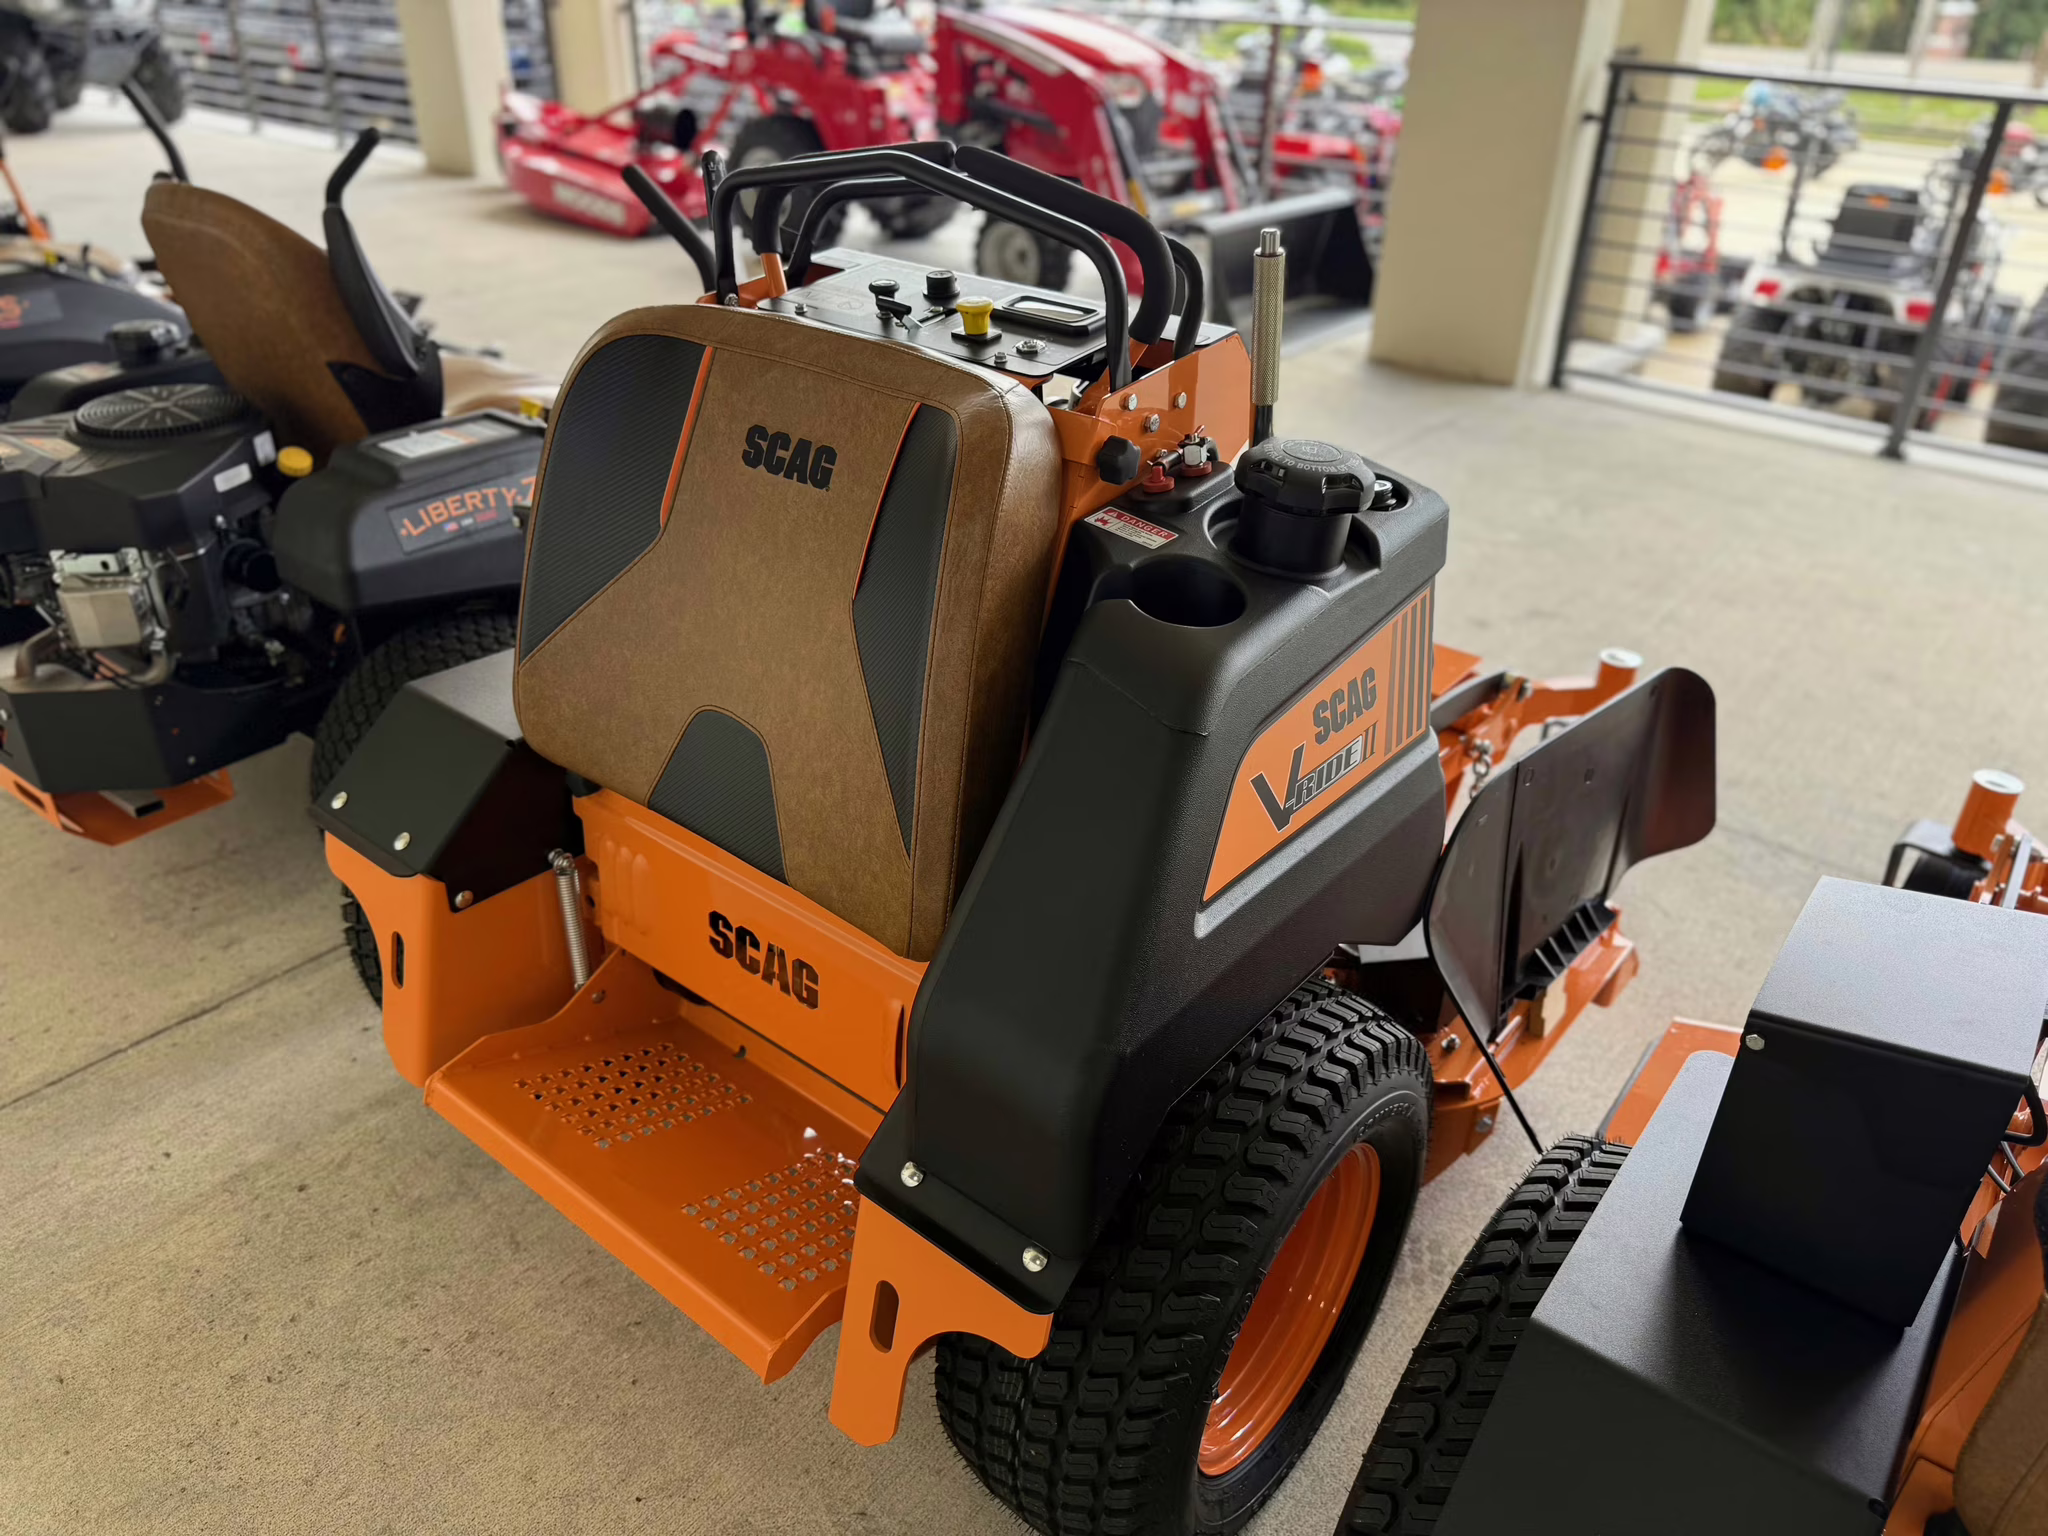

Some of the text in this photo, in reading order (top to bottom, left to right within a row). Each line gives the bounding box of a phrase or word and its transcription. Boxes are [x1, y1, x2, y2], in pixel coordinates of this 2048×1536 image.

[742, 424, 838, 491] SCAG
[1282, 458, 1296, 467] TO
[1296, 463, 1338, 473] BOTTOM
[1120, 514, 1168, 538] DANGER
[1313, 667, 1377, 746] SCAG
[709, 910, 820, 1010] SCAG
